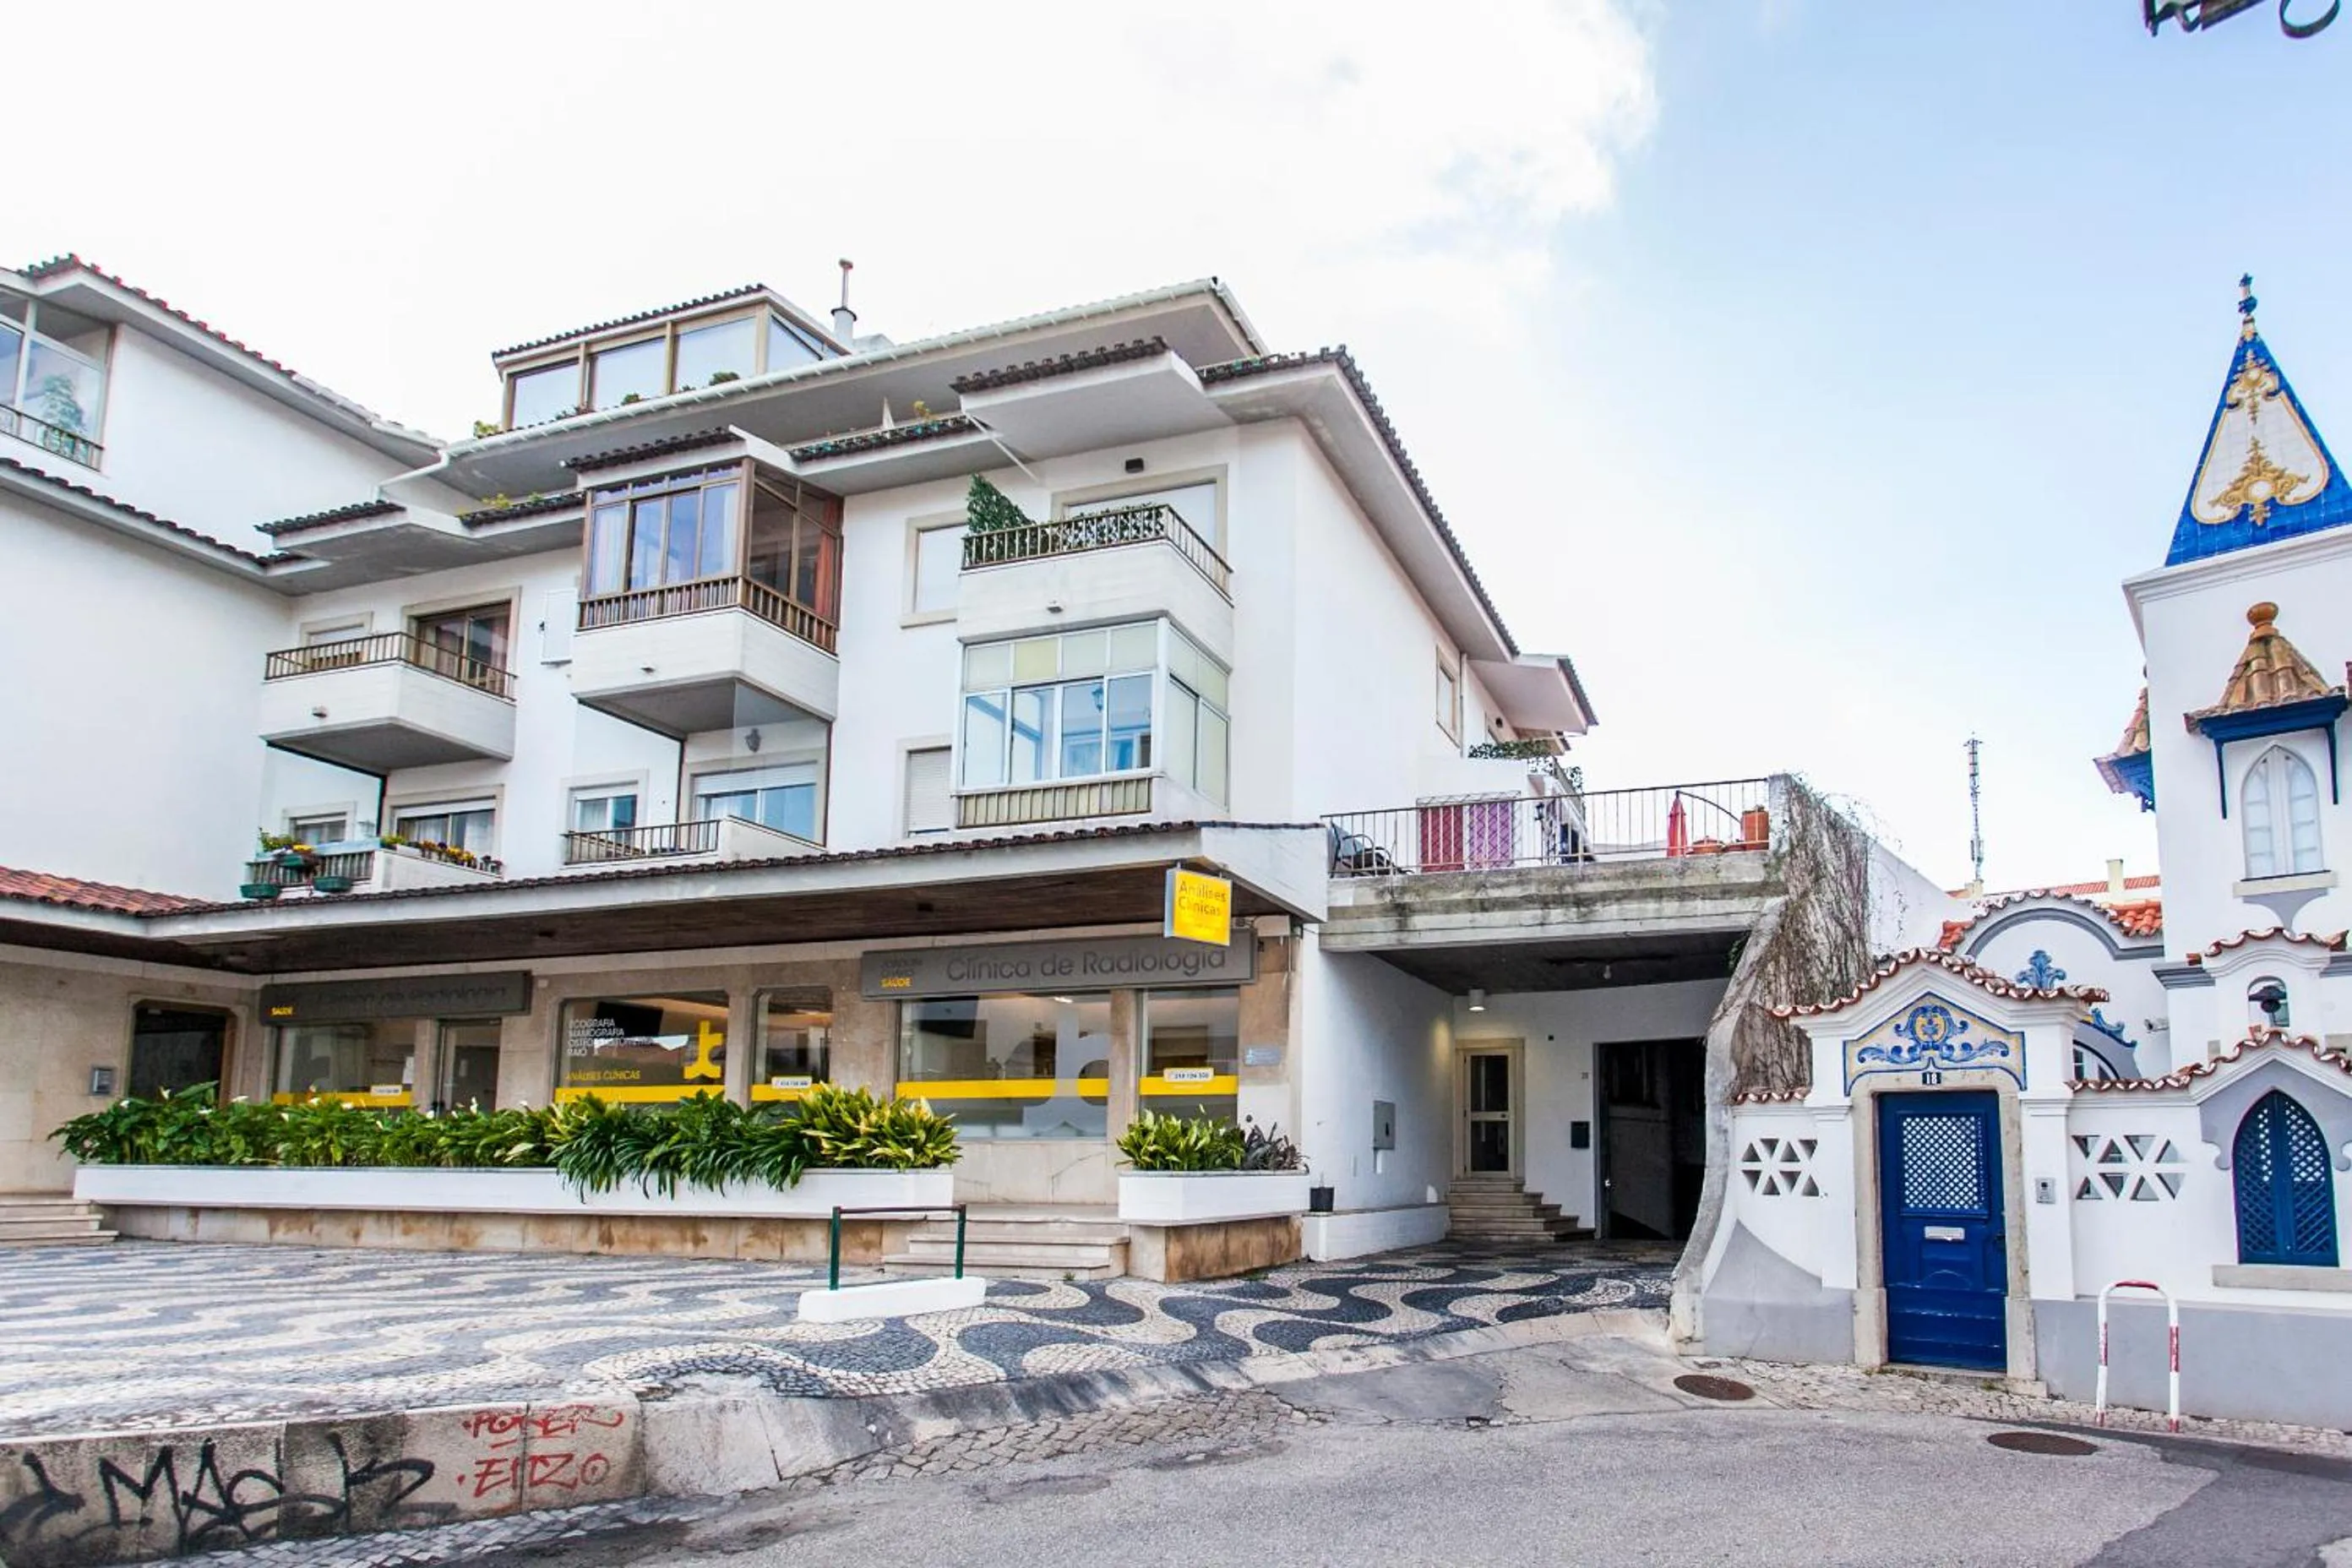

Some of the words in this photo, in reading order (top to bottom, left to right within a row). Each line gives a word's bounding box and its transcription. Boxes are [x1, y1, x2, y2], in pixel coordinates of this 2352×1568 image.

[1040, 952, 1075, 977] de
[1083, 948, 1226, 977] Radiologia
[1926, 1073, 1937, 1085] 18
